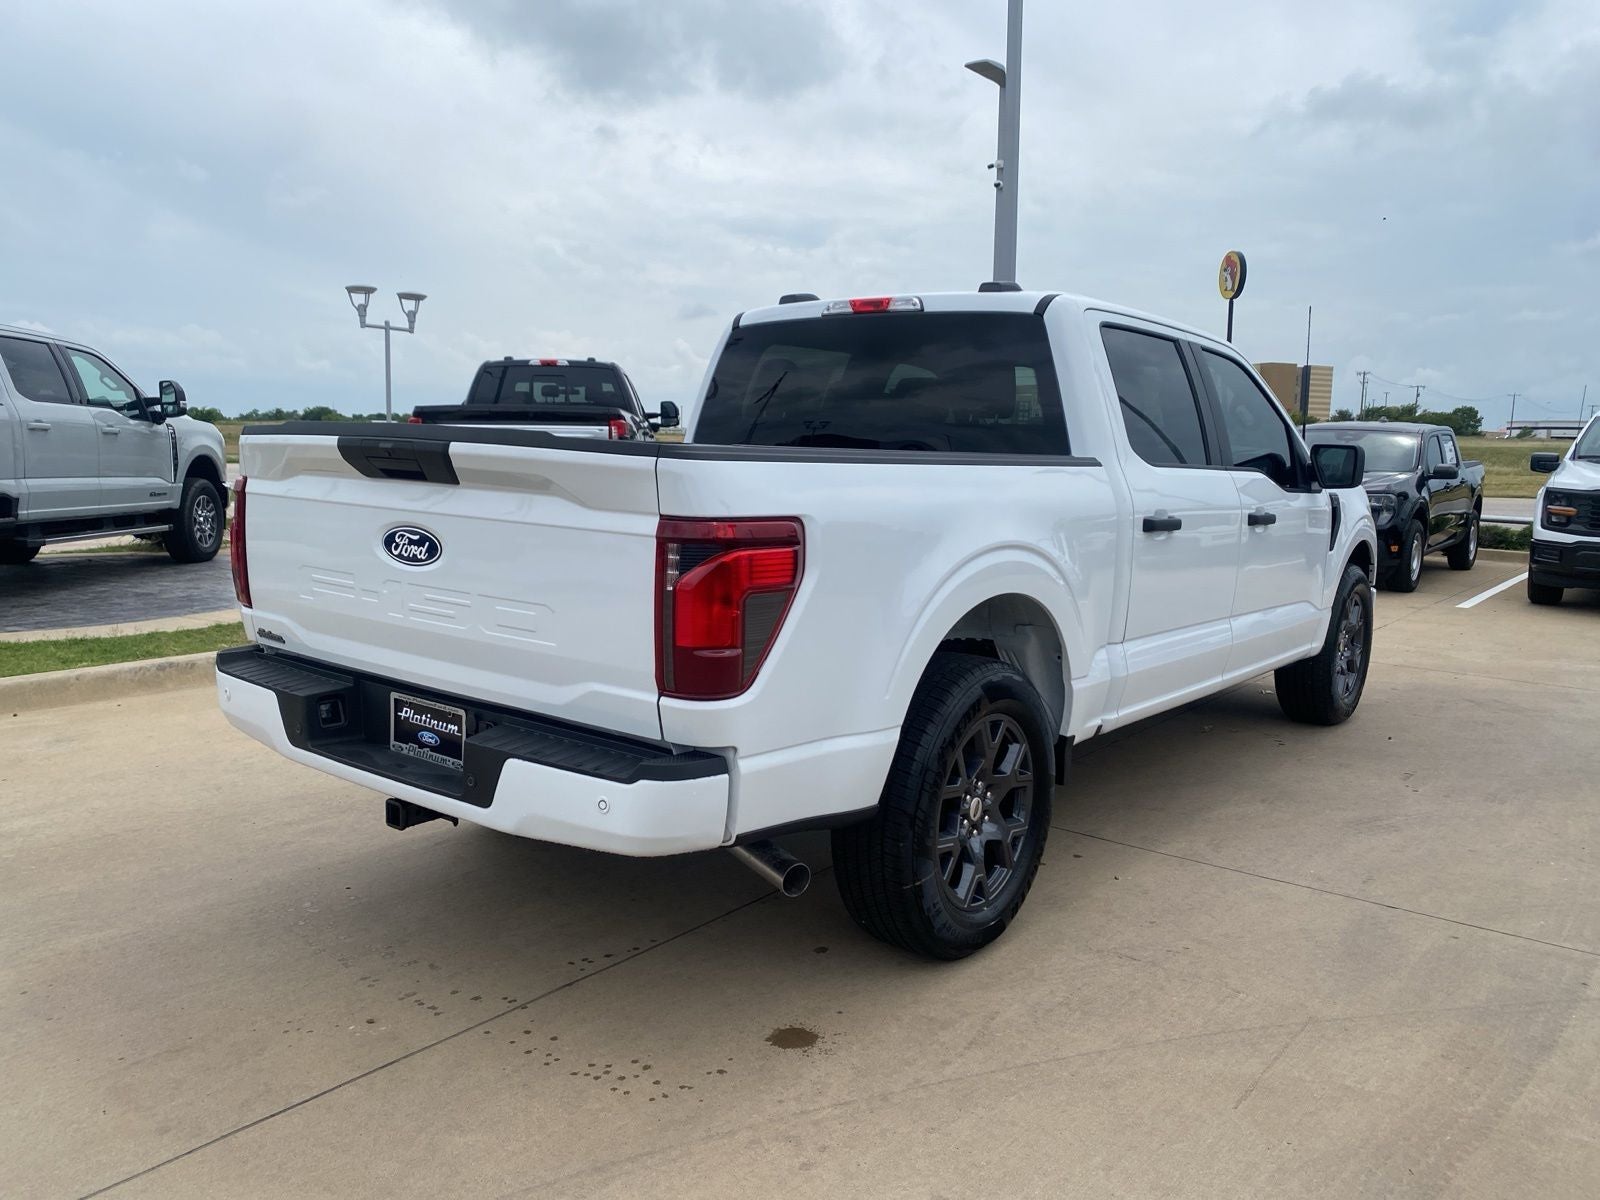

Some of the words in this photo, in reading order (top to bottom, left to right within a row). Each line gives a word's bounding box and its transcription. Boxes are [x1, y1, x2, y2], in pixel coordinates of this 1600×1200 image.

[391, 531, 430, 560] Ford
[298, 565, 557, 646] F-150
[398, 707, 462, 736] Platinum
[421, 732, 437, 745] Ford
[407, 743, 449, 765] Platinum
